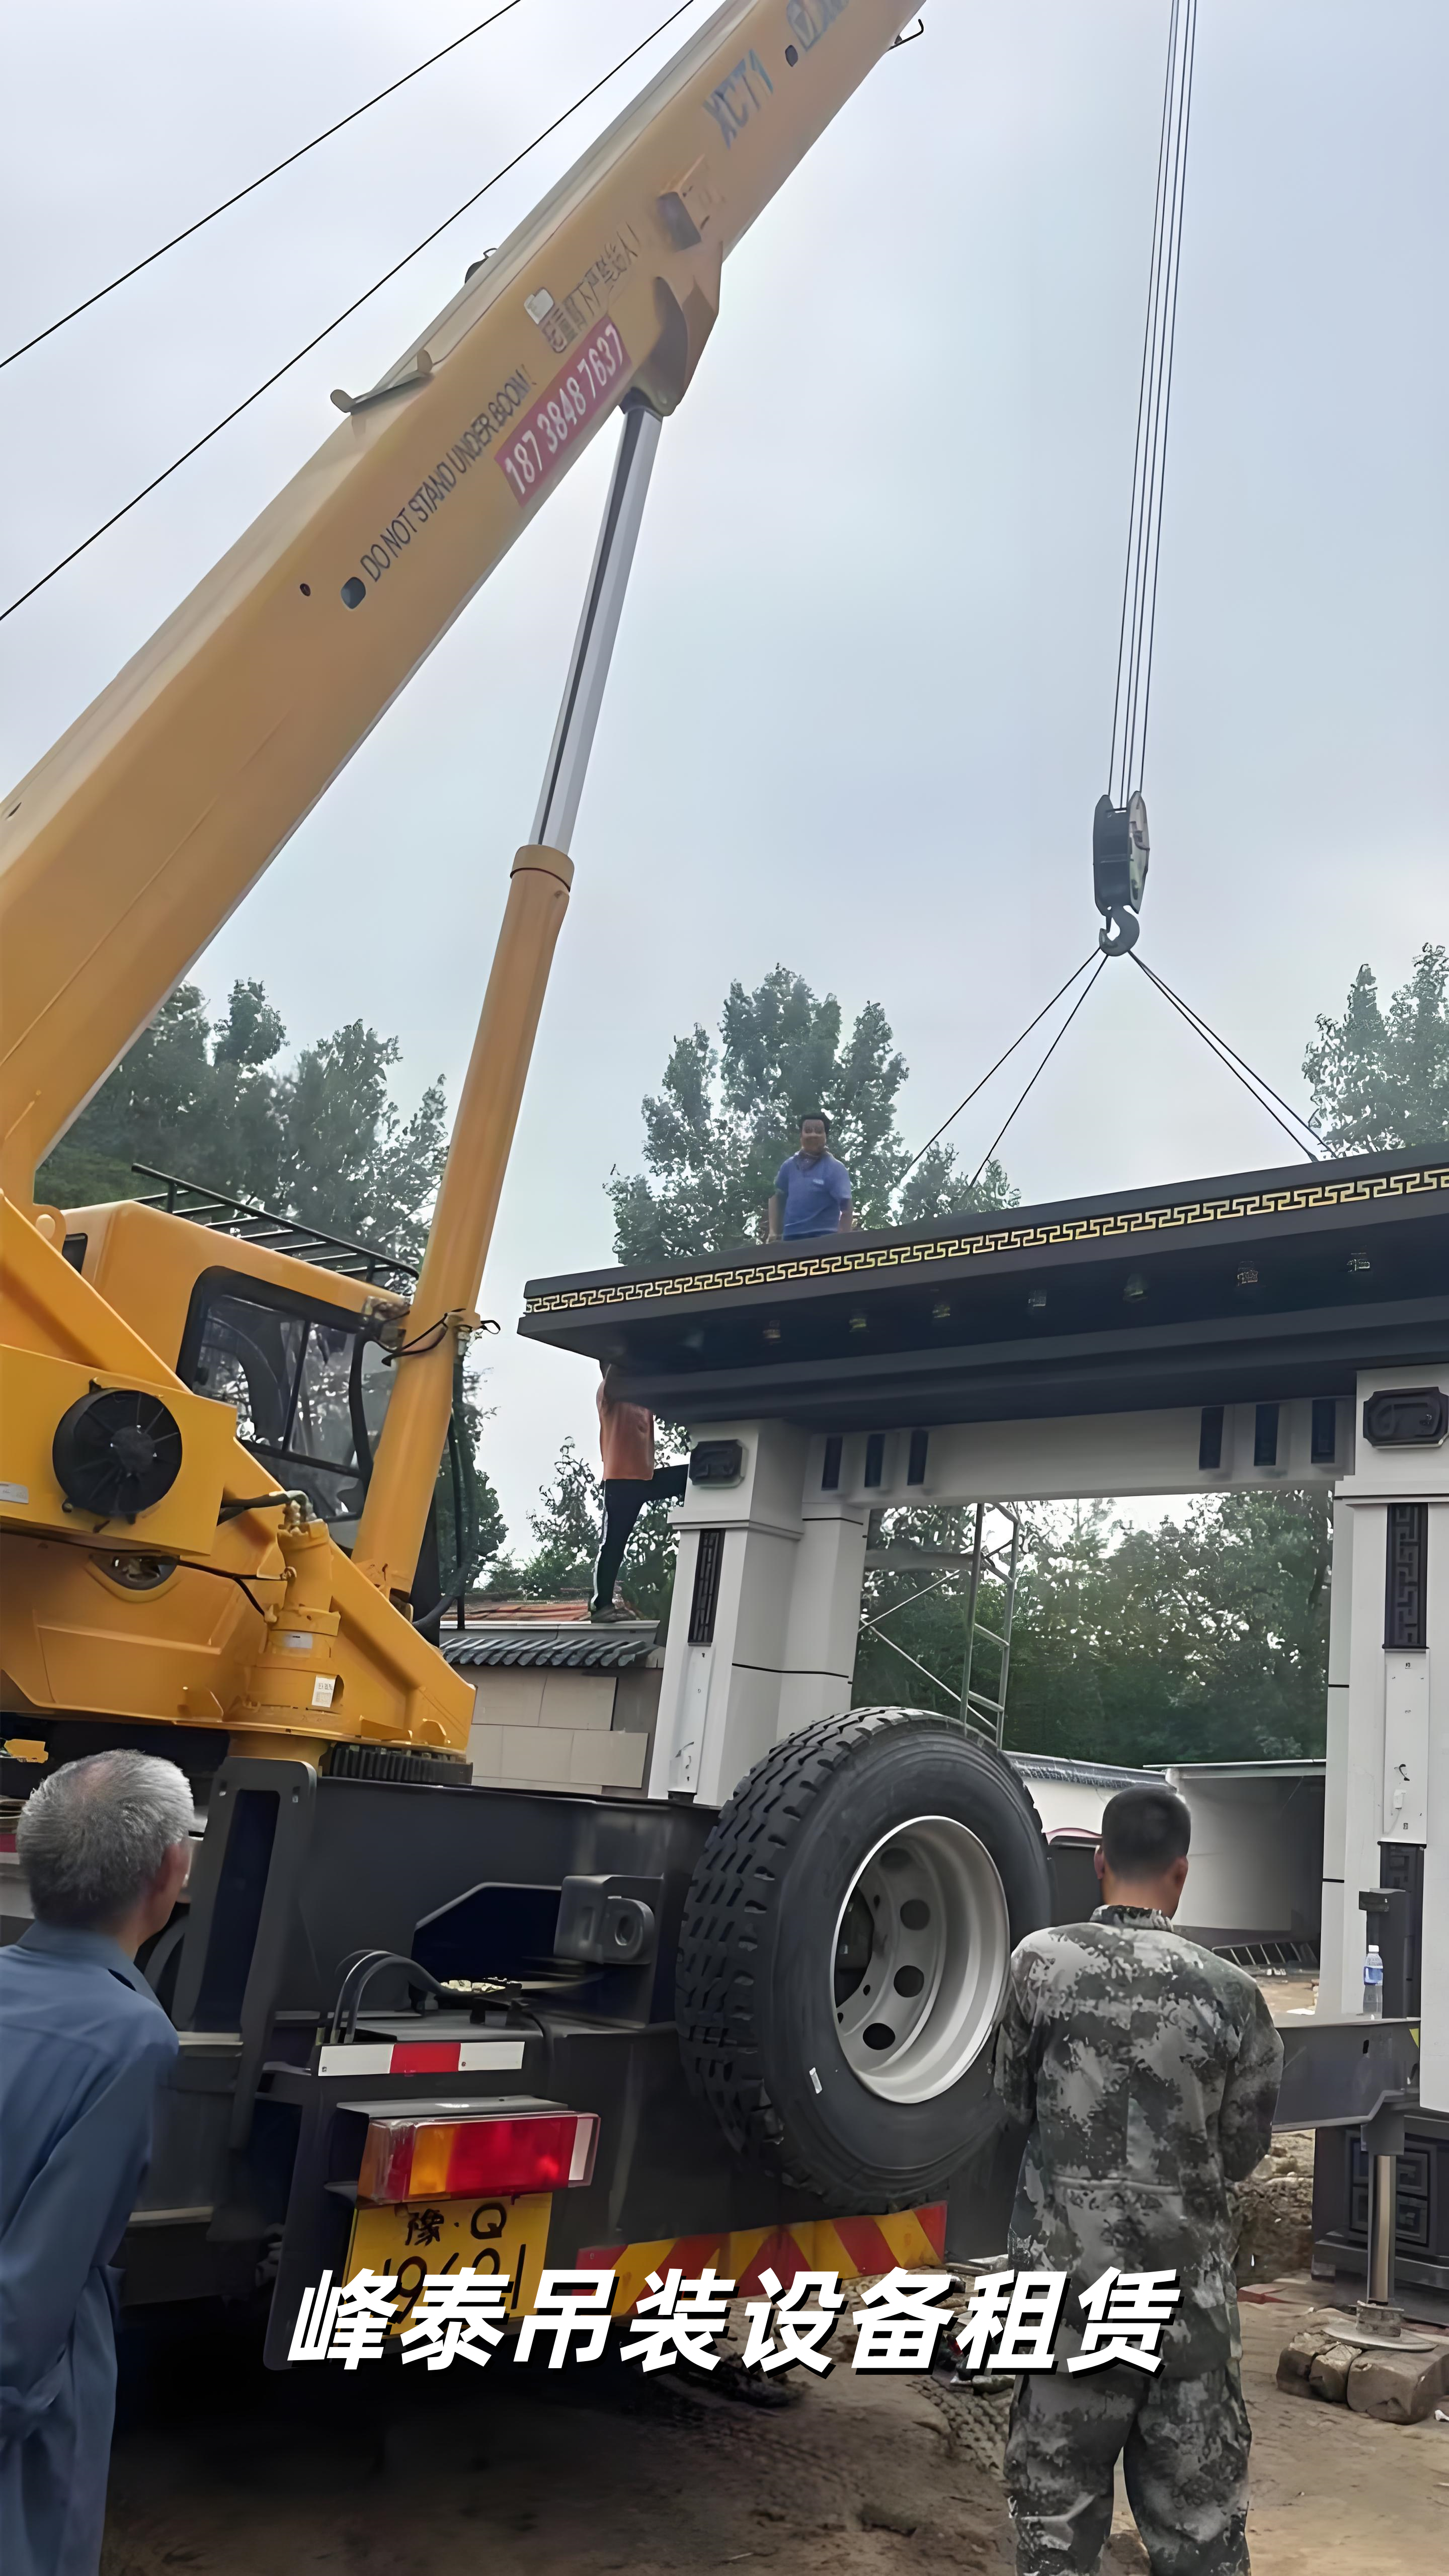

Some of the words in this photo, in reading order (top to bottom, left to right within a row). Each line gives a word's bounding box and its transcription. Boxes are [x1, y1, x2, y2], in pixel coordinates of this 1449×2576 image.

[505, 430, 542, 495] 187
[537, 379, 587, 453] 3848
[577, 323, 623, 399] 7637
[360, 544, 390, 582] DO
[380, 508, 417, 558] NOT
[408, 461, 457, 523] STAND
[445, 413, 498, 474] UNDER
